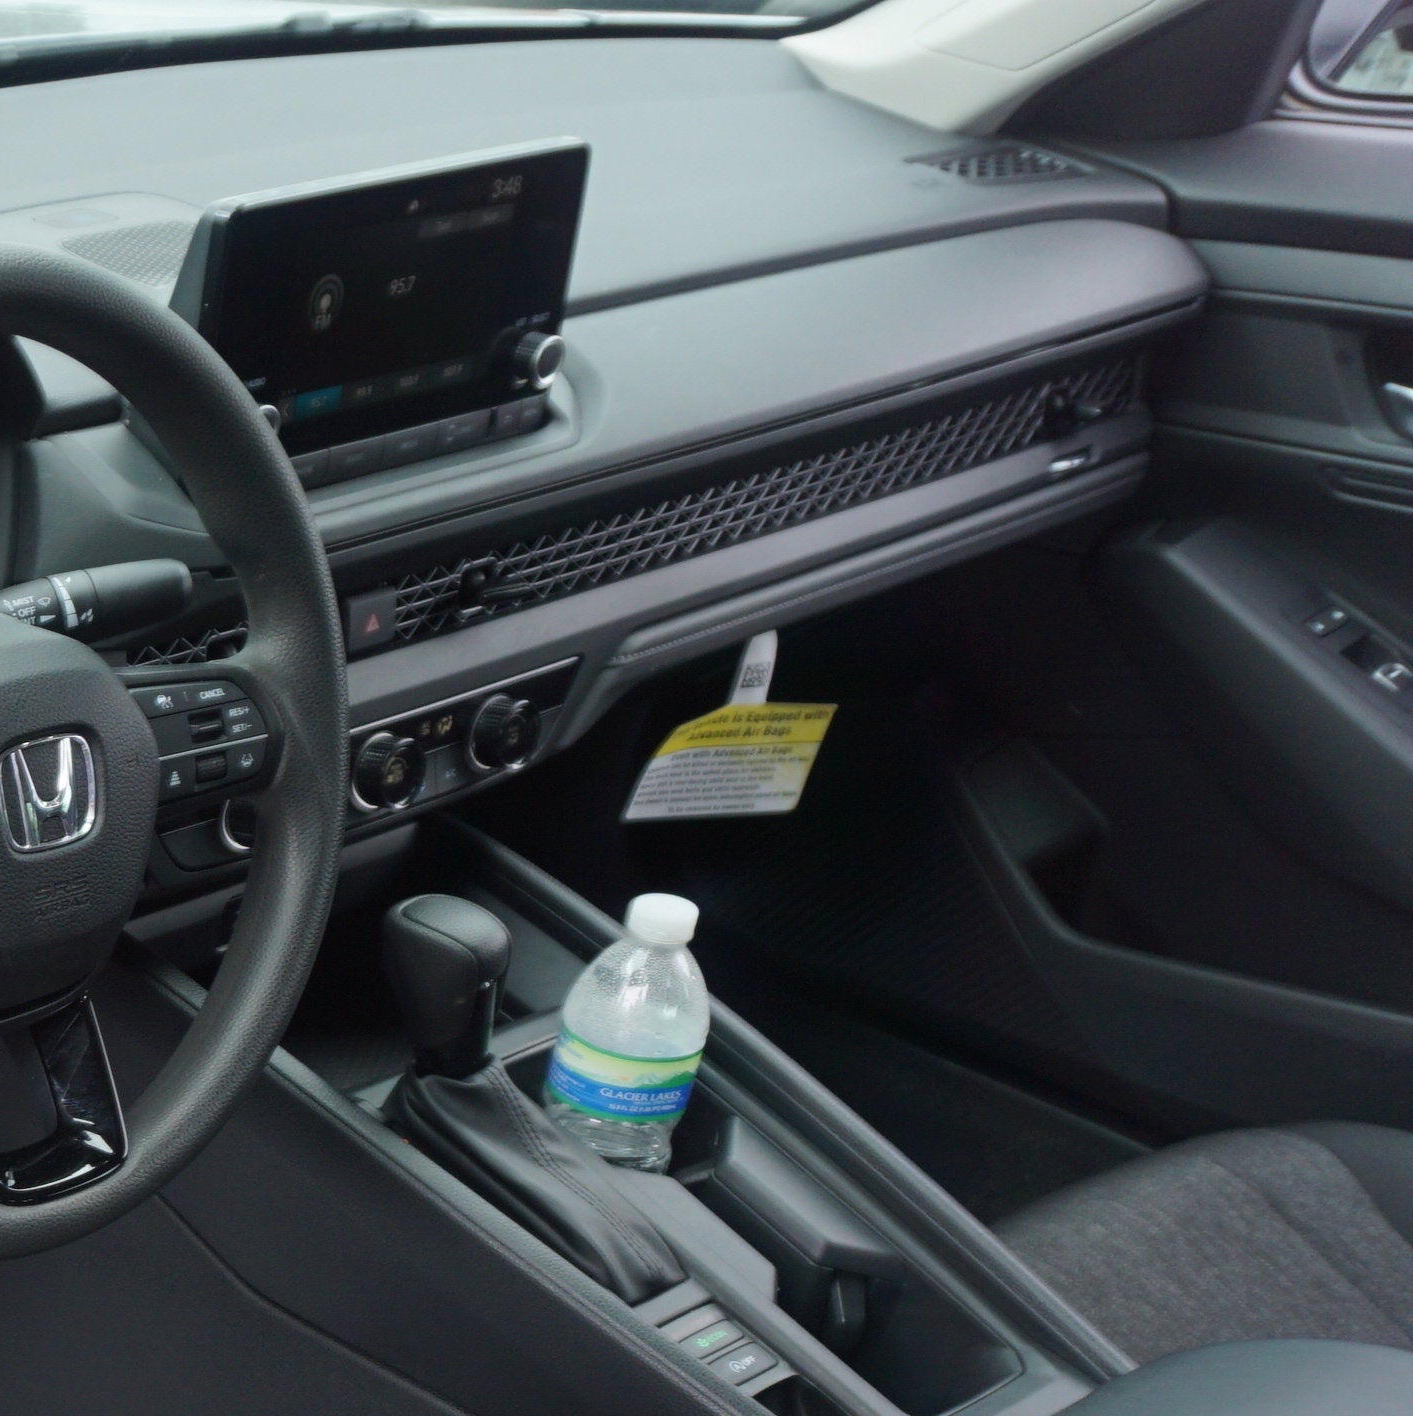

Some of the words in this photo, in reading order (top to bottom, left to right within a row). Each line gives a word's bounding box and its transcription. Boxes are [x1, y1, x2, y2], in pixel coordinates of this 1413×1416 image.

[492, 175, 522, 198] 3:48
[389, 275, 417, 295] 95.7
[11, 595, 34, 606] MIST
[17, 606, 36, 617] OFF
[199, 687, 226, 700] CANCEL
[599, 1087, 649, 1102] GLACIER
[650, 1089, 682, 1102] LAKES
